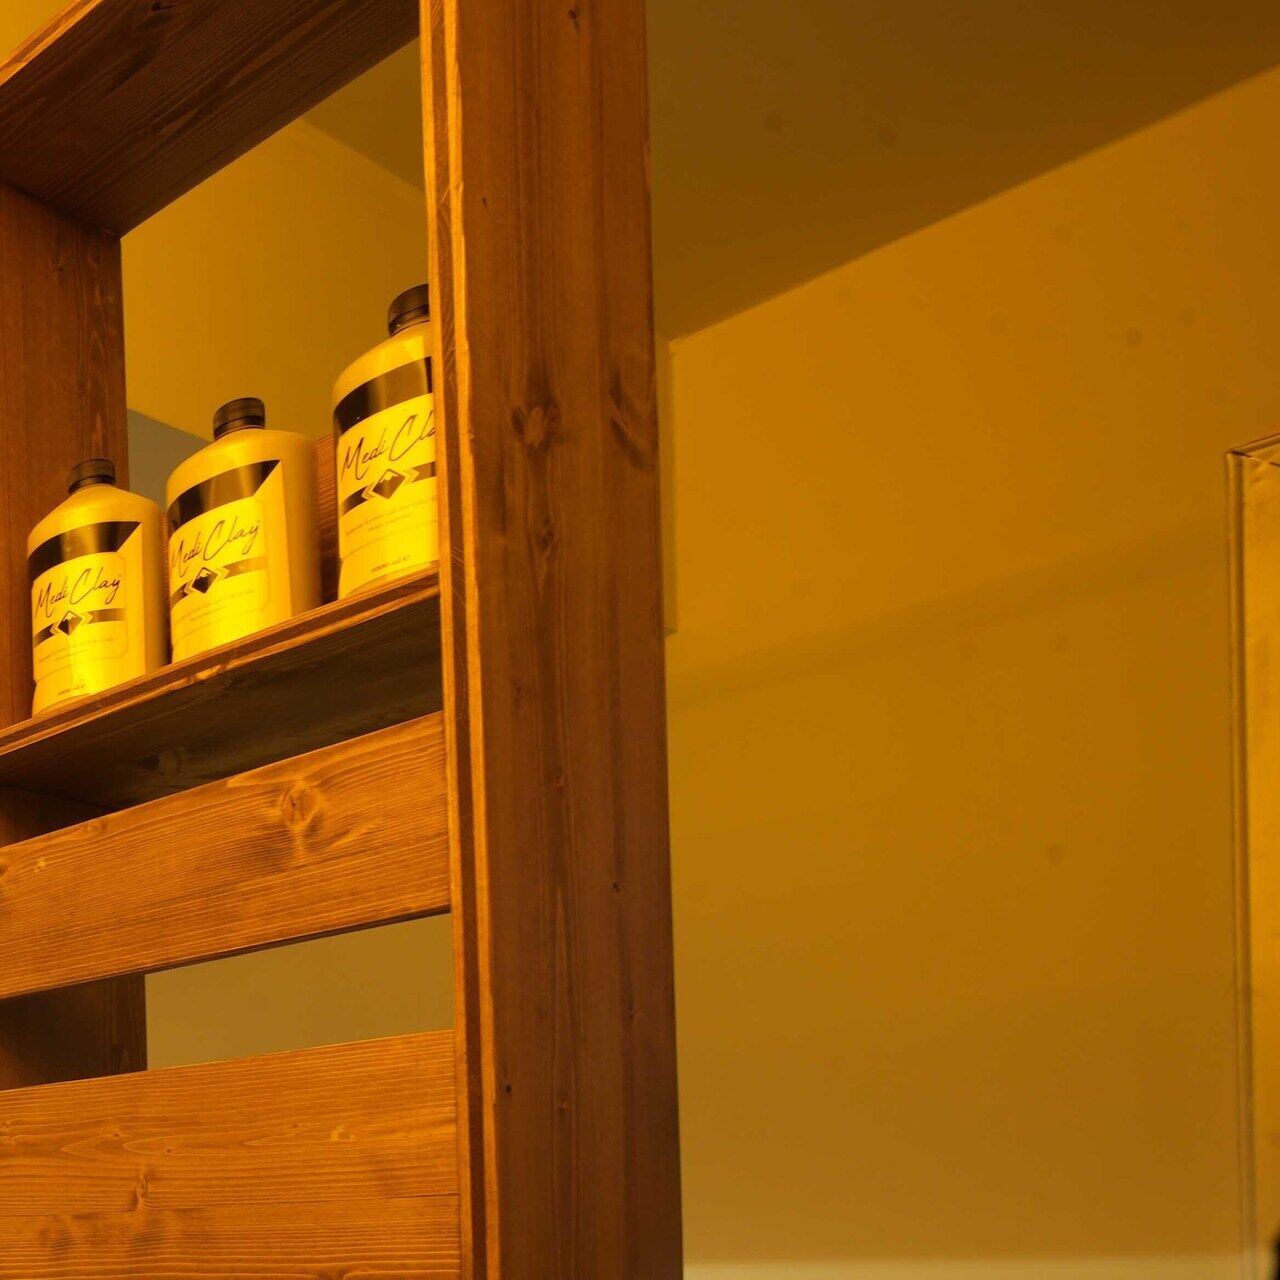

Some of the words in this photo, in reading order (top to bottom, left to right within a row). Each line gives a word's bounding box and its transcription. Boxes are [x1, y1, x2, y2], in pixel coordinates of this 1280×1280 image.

[340, 428, 387, 481] Medi
[389, 410, 436, 462] Cla
[172, 531, 202, 578] Medi
[203, 516, 260, 560] Clay
[35, 576, 69, 618] Medi
[70, 567, 122, 605] Clay
